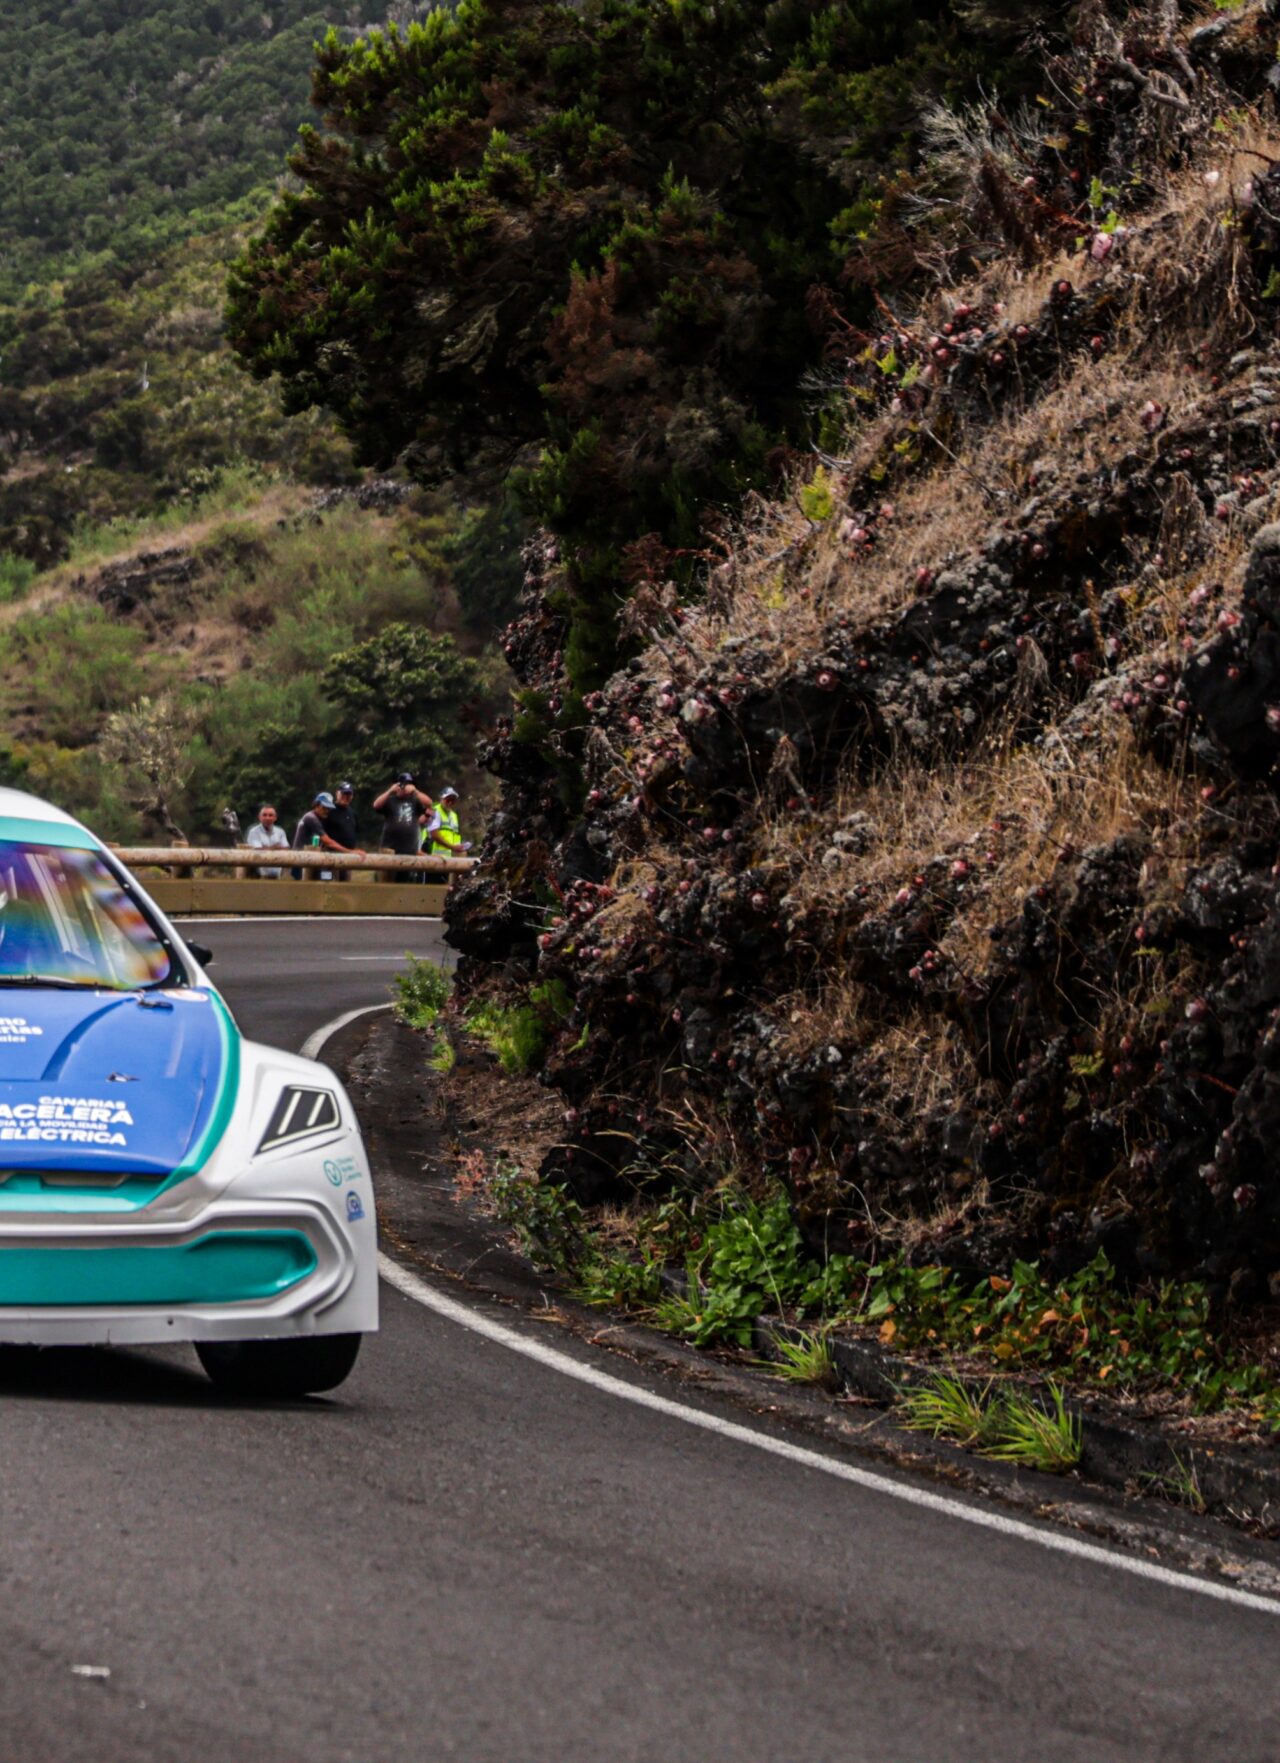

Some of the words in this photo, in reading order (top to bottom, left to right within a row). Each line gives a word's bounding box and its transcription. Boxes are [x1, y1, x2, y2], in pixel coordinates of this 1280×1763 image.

[39, 1096, 126, 1110] CANARIAS
[20, 1120, 37, 1128] LA
[39, 1120, 108, 1130] MOVILIDAD
[0, 1128, 127, 1146] ELÉCTRICA
